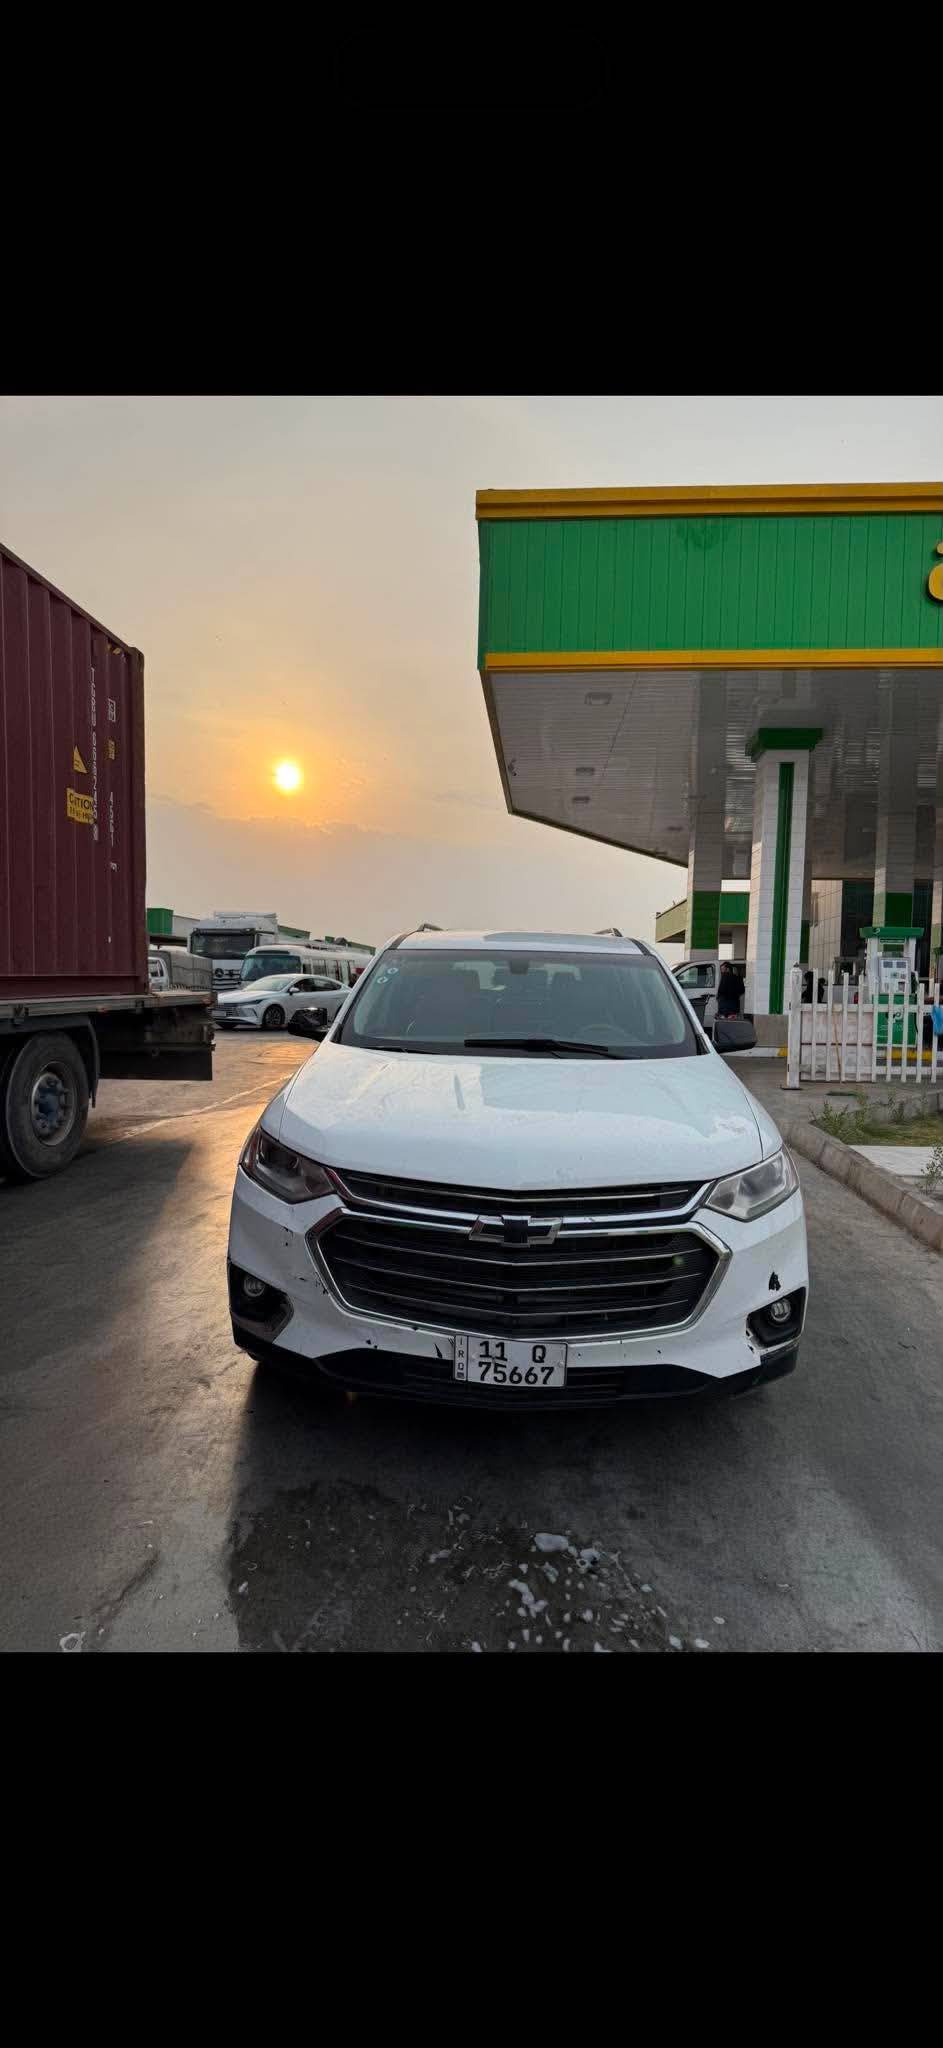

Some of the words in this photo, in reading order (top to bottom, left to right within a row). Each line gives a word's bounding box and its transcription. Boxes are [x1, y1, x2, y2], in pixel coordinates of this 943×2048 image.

[479, 1340, 508, 1362] 11
[532, 1344, 547, 1364] Q
[478, 1361, 554, 1385] 75667
